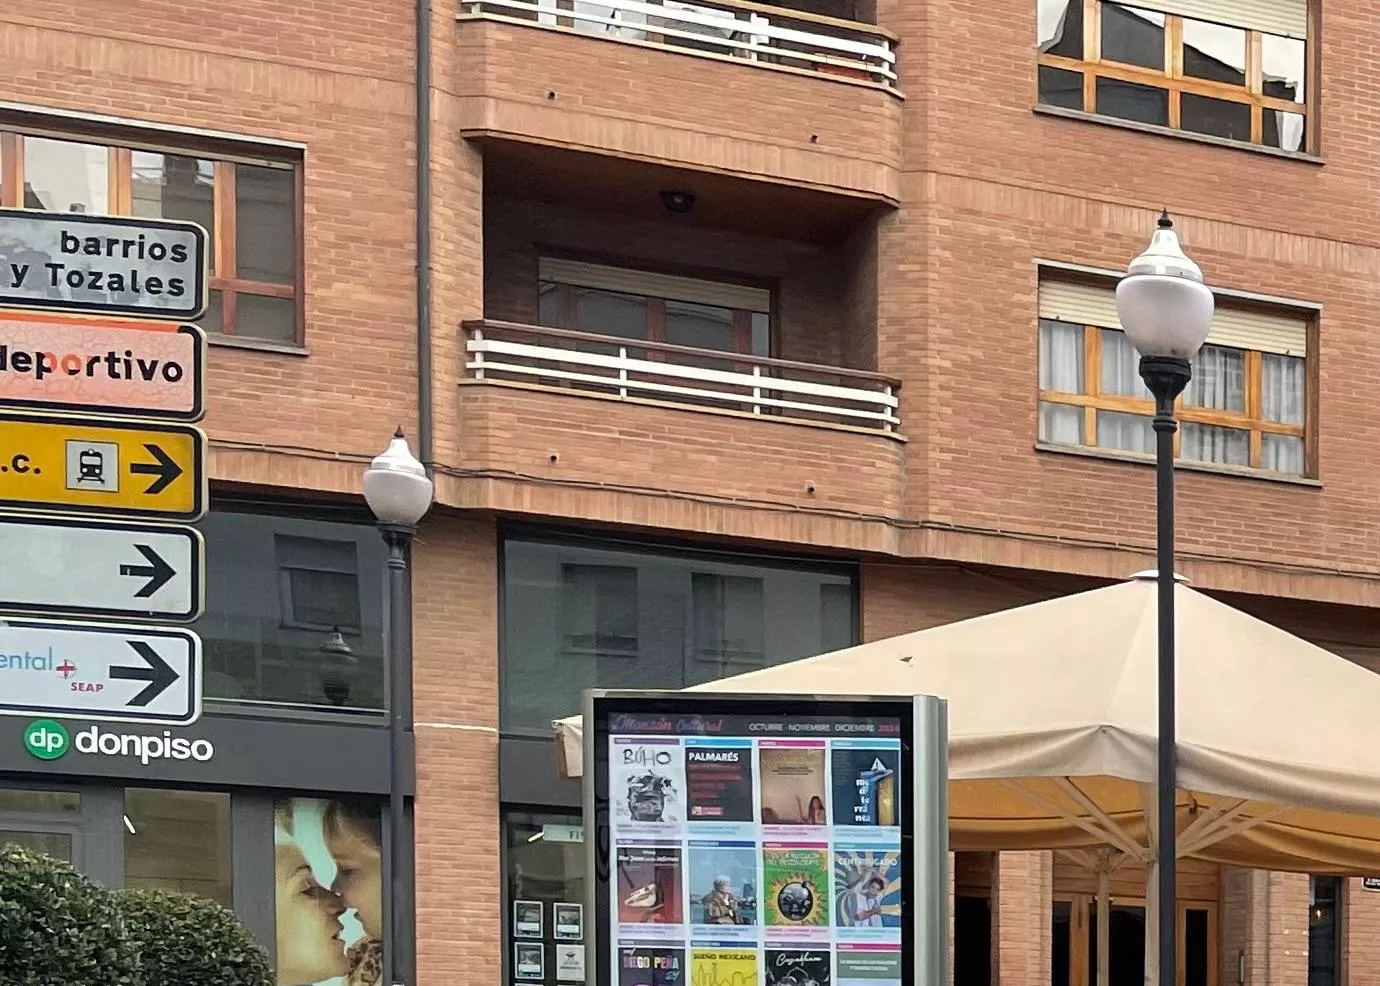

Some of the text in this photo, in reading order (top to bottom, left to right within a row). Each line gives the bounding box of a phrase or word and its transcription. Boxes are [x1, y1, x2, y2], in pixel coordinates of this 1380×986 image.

[61, 230, 188, 263] barrios
[11, 263, 185, 296] y Tozales
[71, 682, 104, 693] SEAP
[30, 725, 214, 765] dp donpiso
[623, 746, 672, 767] BÚHO
[688, 752, 739, 762] PALMARÉS
